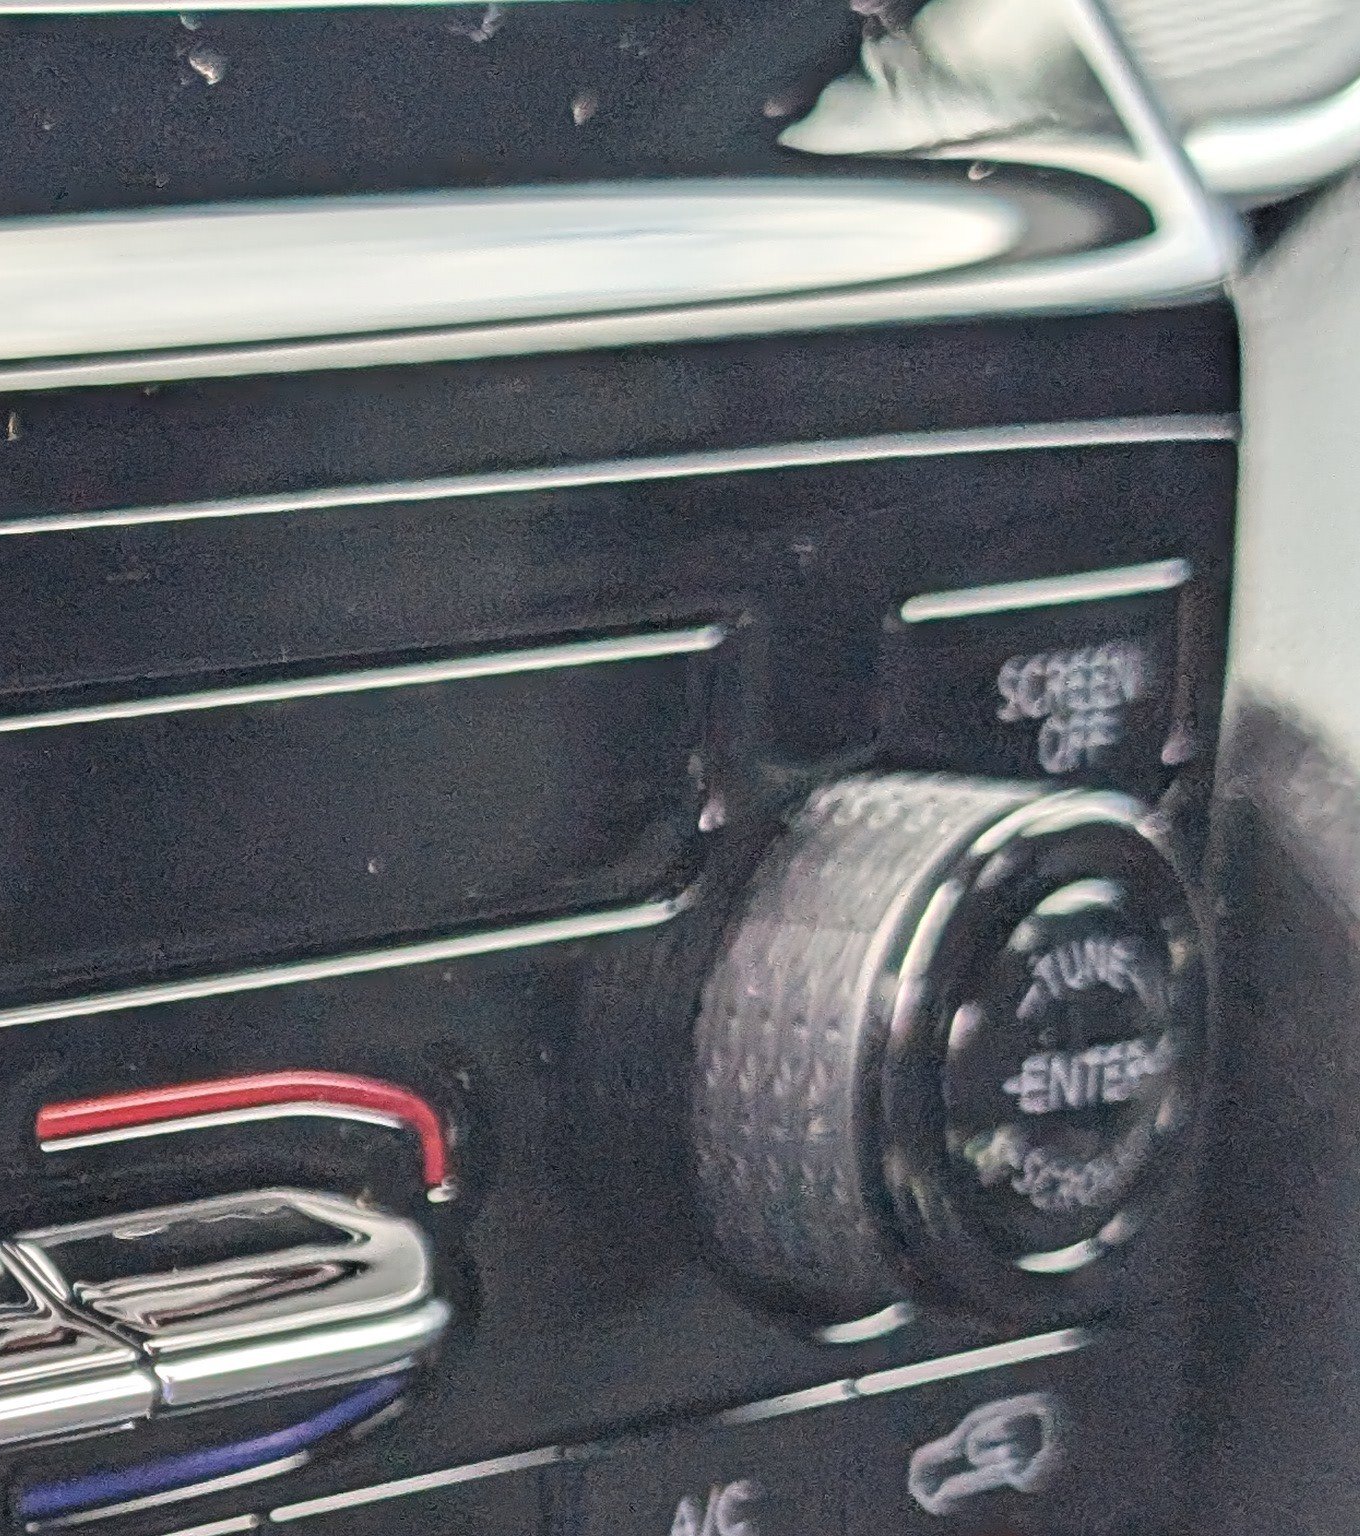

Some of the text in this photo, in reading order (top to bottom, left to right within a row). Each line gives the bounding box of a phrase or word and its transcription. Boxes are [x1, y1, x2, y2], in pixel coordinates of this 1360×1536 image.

[1037, 710, 1122, 774] OFF
[1030, 938, 1134, 998] TUNE
[1018, 1038, 1154, 1114] ENTER
